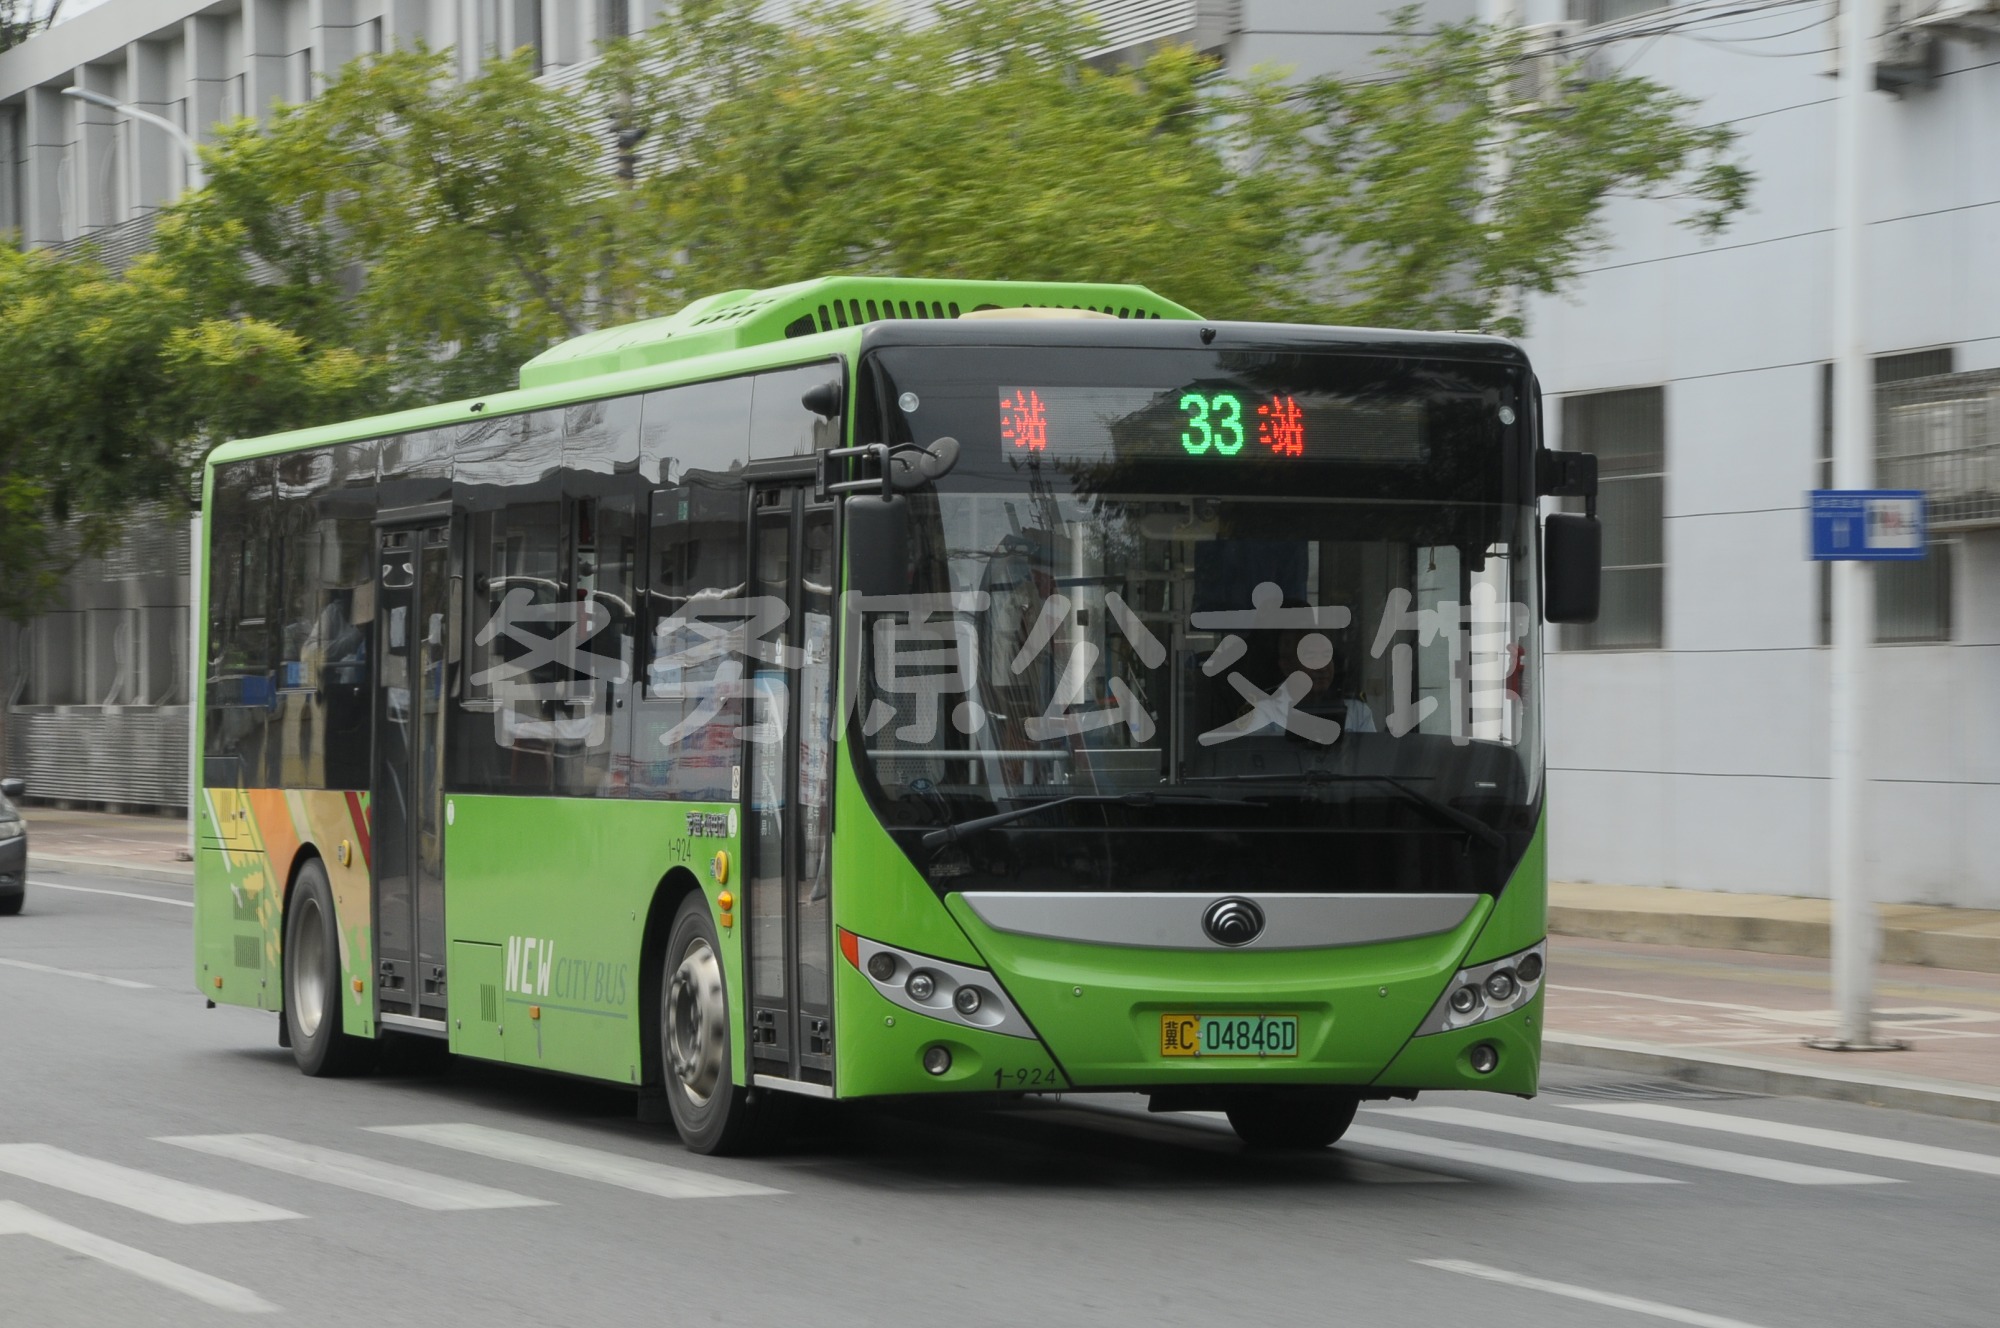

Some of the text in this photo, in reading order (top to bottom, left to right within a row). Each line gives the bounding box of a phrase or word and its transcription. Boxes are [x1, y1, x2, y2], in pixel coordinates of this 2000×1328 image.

[1180, 394, 1244, 455] 33
[668, 838, 691, 862] 1-924
[505, 935, 628, 1005] NEW CITY BUS
[1206, 1021, 1296, 1050] 04846D
[993, 1068, 1057, 1089] 1-924
